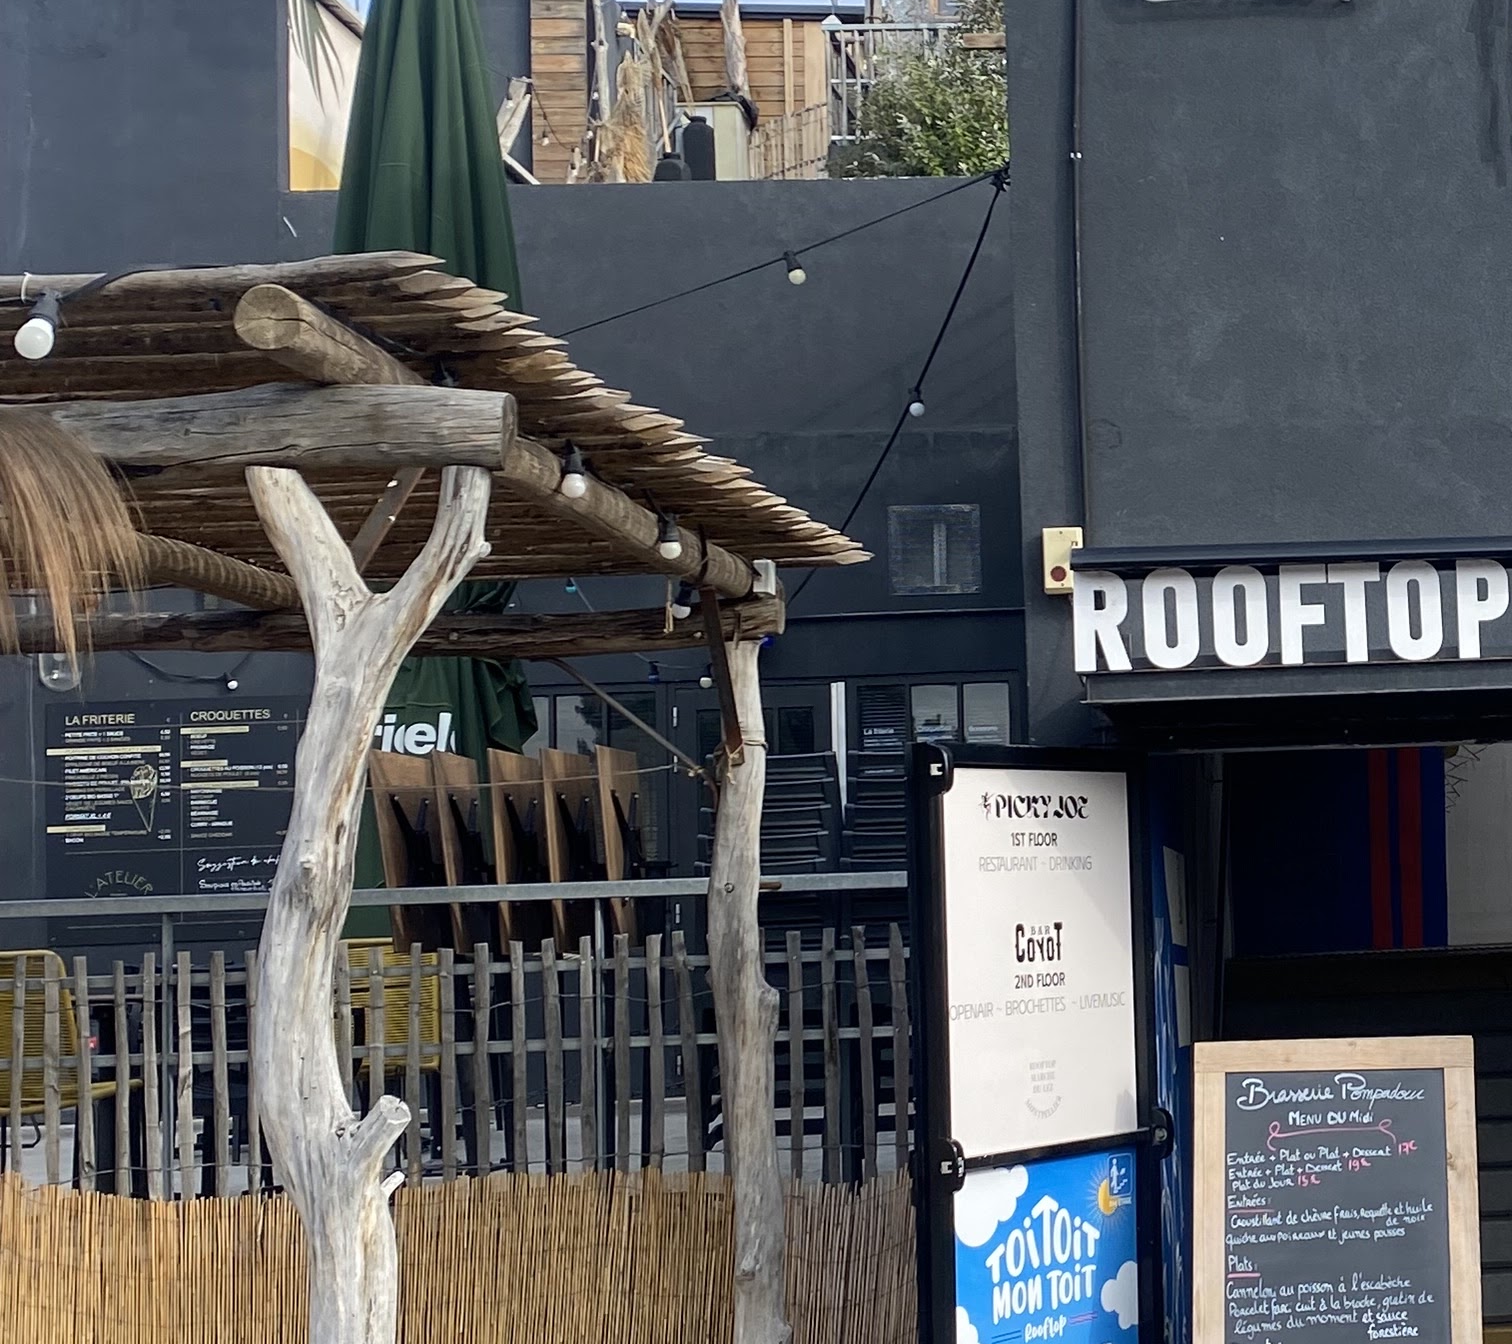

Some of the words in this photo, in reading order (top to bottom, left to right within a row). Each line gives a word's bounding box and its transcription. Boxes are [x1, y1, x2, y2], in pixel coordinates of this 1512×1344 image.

[1074, 558, 1509, 672] ROOFTOP
[65, 715, 80, 726] LA
[82, 713, 135, 725] FRITERIE
[189, 708, 271, 722] CROQUETTES
[995, 794, 1051, 819] PICKY
[1053, 795, 1089, 819] JOE
[1011, 832, 1025, 847] 1ST
[1029, 832, 1058, 847] FLOOR
[978, 856, 1038, 873] RESTAURANT
[1049, 855, 1093, 872] DRINKING
[1014, 974, 1033, 990] 2ND
[1037, 972, 1066, 988] FLOOR
[1005, 996, 1066, 1017] BROCHETTES
[1236, 1077, 1335, 1111] Brasserie
[1227, 1151, 1267, 1166] Entrée
[1280, 1148, 1301, 1162] Plat
[1303, 1152, 1316, 1161] ou
[1318, 1146, 1340, 1160] Plat
[1352, 1145, 1393, 1158] Dessert
[1228, 1166, 1265, 1181] Entrée
[1275, 1163, 1296, 1176] Plat
[1305, 1159, 1343, 1174] Dessert
[1232, 1179, 1252, 1193] Plat
[1252, 1178, 1266, 1189] du
[1286, 1209, 1299, 1225] de
[1393, 1201, 1405, 1215] et
[1405, 1197, 1433, 1216] huile
[1385, 1215, 1400, 1227] de
[1338, 1229, 1371, 1246] jeunes
[993, 1274, 1043, 1325] MON
[1279, 1285, 1295, 1297] au
[1298, 1282, 1334, 1302] poisson
[1295, 1295, 1316, 1312] cuit
[1329, 1294, 1341, 1309] la
[1417, 1290, 1435, 1305] de
[1024, 1314, 1068, 1344] Rooftop
[1233, 1318, 1283, 1340] légumes
[1286, 1313, 1306, 1329] du
[1306, 1309, 1359, 1325] moment
[1361, 1308, 1375, 1324] et
[1375, 1310, 1409, 1324] sauce
[1367, 1321, 1419, 1341] forestière
